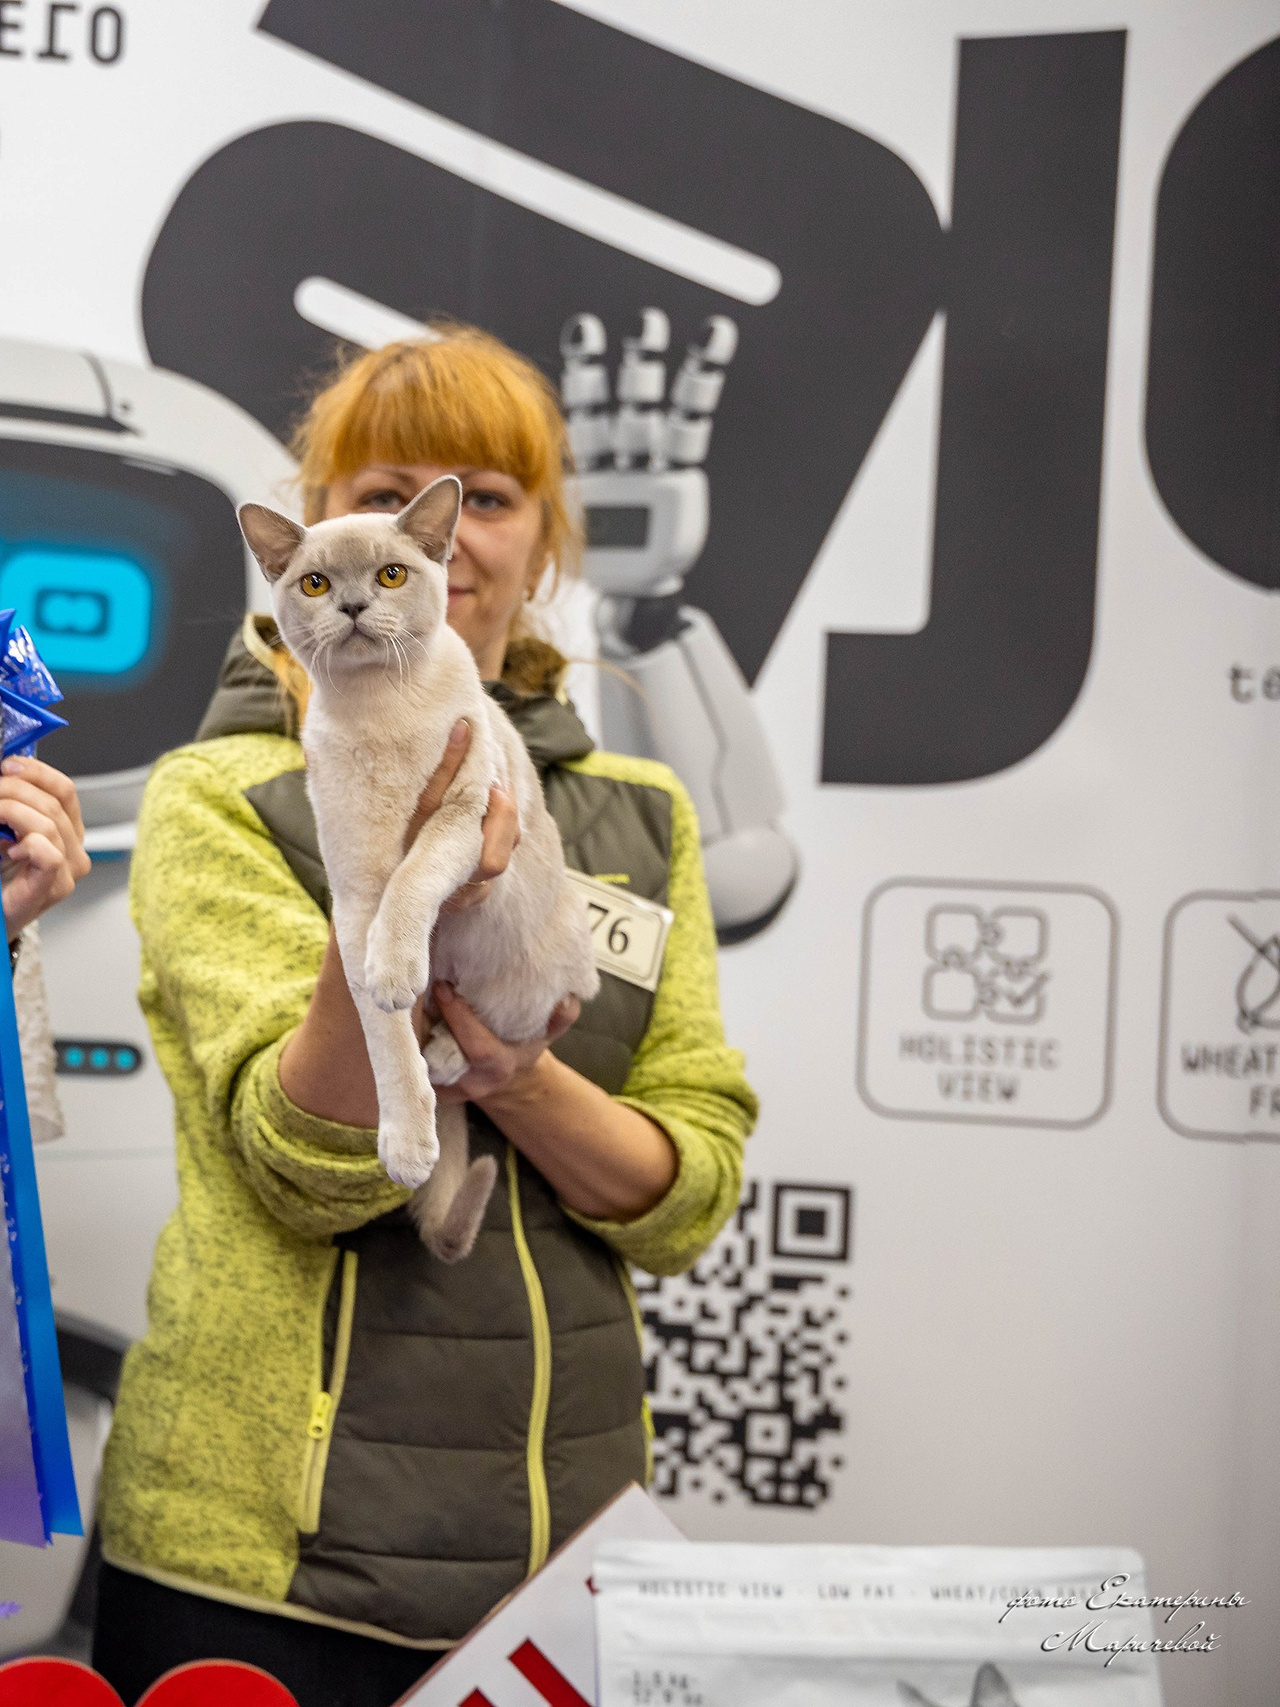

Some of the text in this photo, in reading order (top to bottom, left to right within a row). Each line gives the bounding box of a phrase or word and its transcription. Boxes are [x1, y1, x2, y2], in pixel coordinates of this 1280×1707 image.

[900, 1033, 1061, 1070] HOLISTIC
[937, 1071, 1019, 1102] VIEW
[739, 1582, 784, 1598] VIEW
